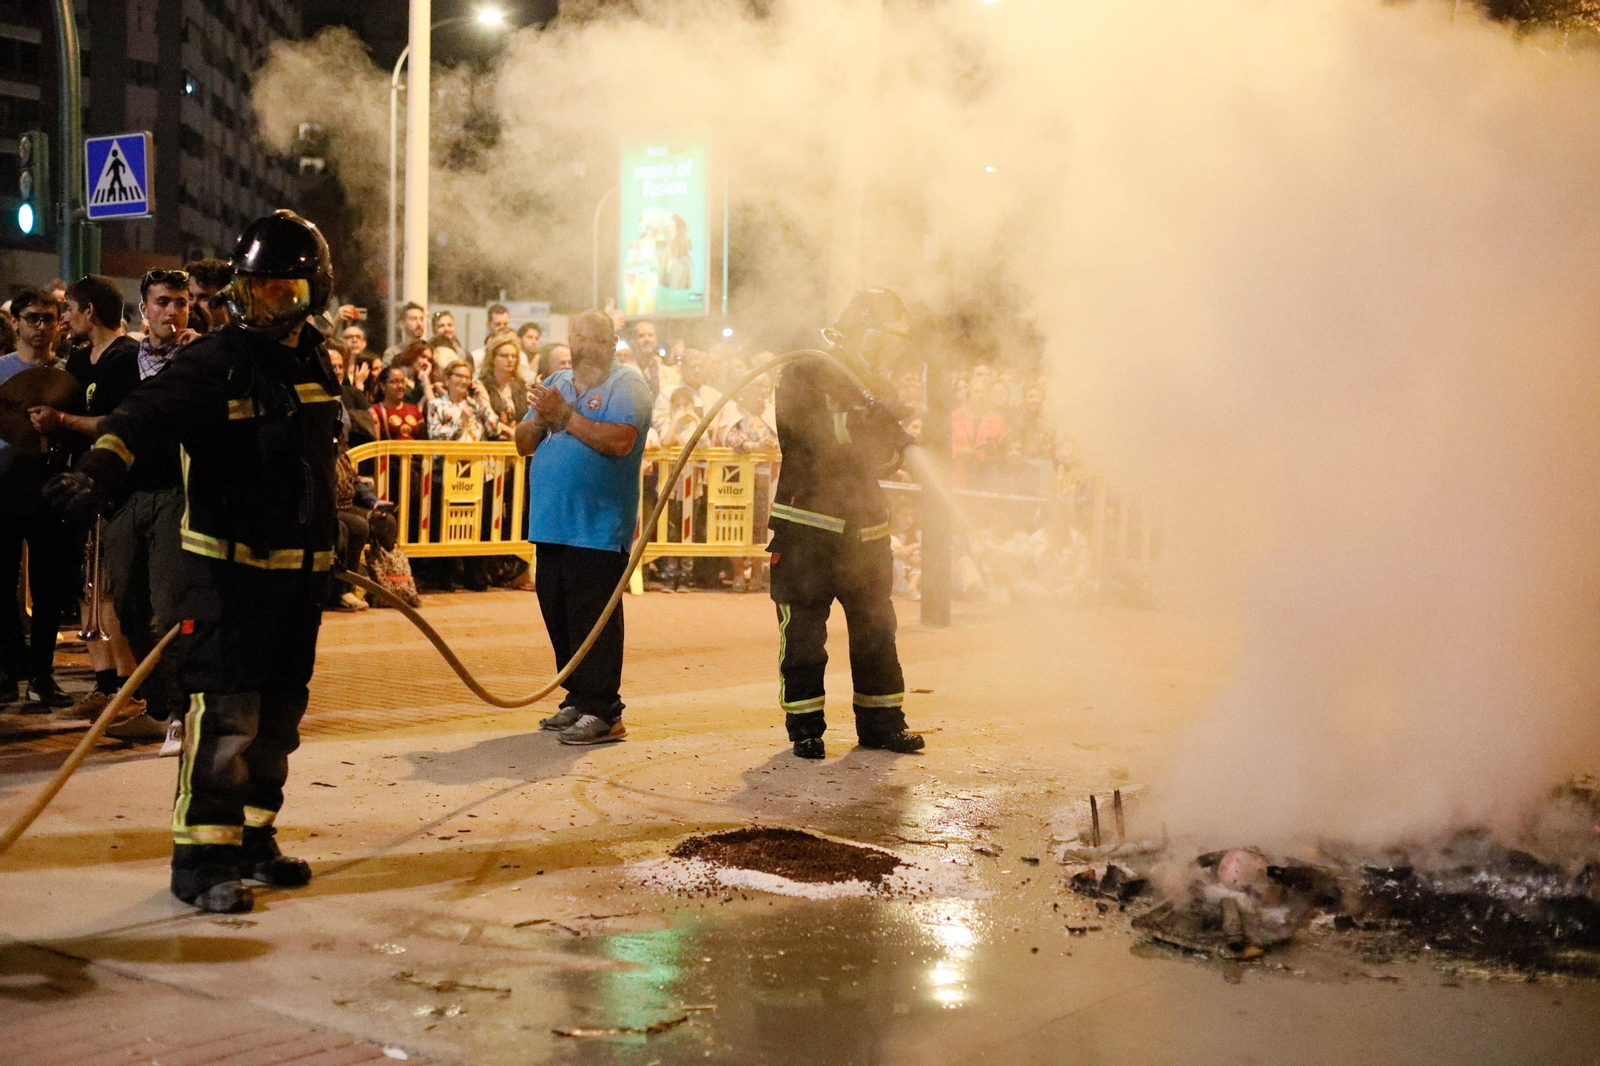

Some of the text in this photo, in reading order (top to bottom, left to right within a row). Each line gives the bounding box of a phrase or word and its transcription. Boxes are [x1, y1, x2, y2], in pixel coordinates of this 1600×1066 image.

[676, 157, 694, 177] of
[642, 178, 687, 198] fusion
[451, 481, 474, 491] villar
[717, 485, 744, 495] villar
